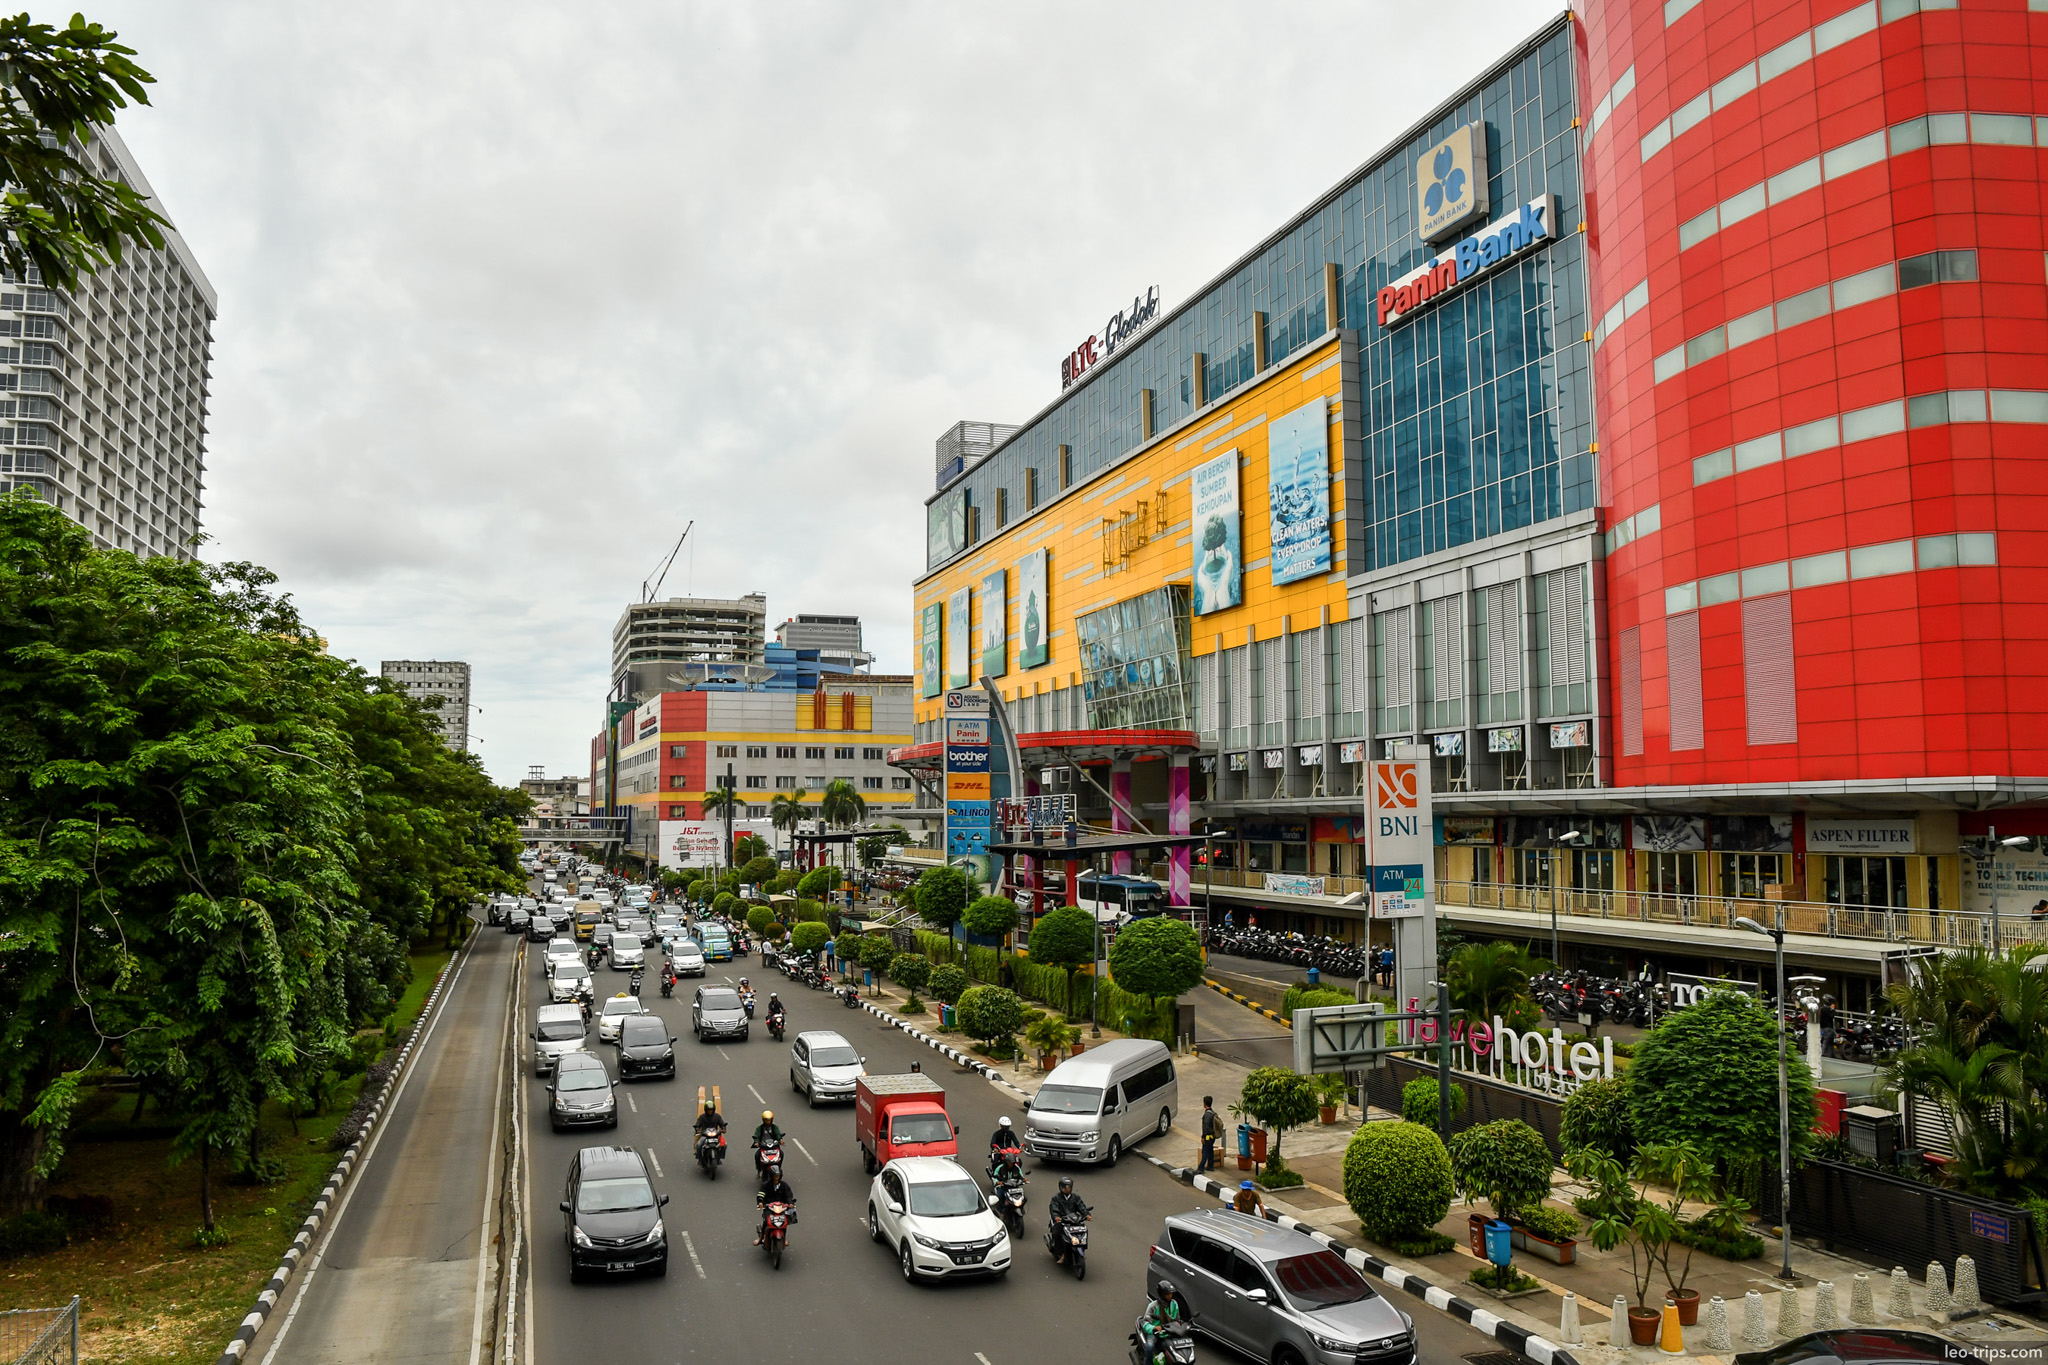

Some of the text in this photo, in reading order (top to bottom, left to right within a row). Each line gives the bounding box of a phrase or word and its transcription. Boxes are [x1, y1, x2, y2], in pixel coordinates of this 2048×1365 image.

[1424, 200, 1468, 233] PANIN BANK
[1377, 203, 1546, 327] PaninBank
[1071, 335, 1098, 380] LTC
[1105, 285, 1159, 356] Glodok
[1196, 457, 1231, 485] AIR BERSIH
[1200, 476, 1227, 499] SUMBER
[1196, 489, 1233, 517] KEHIDUPAN
[1271, 514, 1328, 544] CLEAN WATERS,
[1277, 536, 1322, 560] EVERY DROP
[1283, 558, 1317, 578] MATTERS
[949, 751, 988, 762] brother
[953, 782, 984, 790] DHL
[958, 808, 990, 817] ALINCO
[680, 827, 700, 835] J&T
[1379, 816, 1418, 837] BNI
[1811, 829, 1910, 842] ASPEN FILTER
[1382, 869, 1404, 880] ATM
[1404, 878, 1421, 893] 24
[1974, 1227, 2005, 1241] 24 Jam
